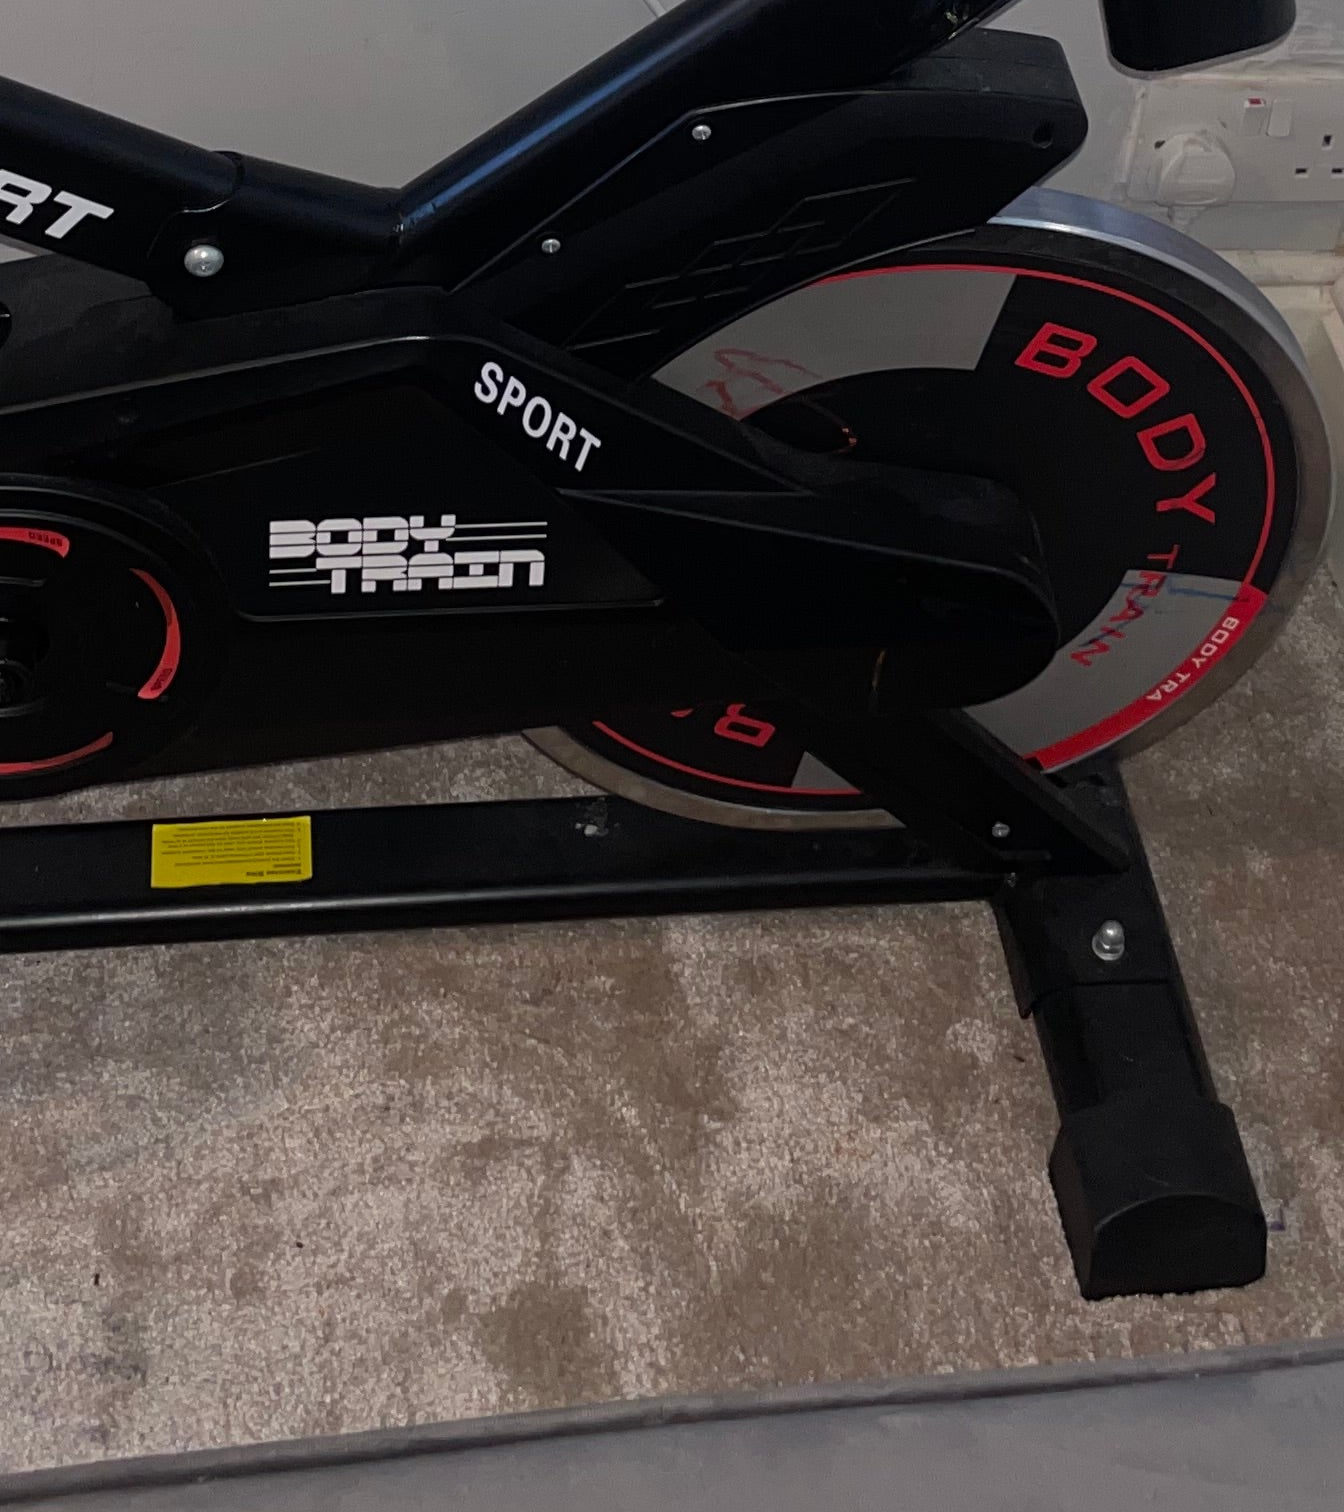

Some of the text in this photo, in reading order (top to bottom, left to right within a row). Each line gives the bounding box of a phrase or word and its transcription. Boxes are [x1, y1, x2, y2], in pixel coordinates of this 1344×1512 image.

[474, 361, 602, 472] SPORT
[1014, 321, 1217, 525] BODY
[269, 514, 456, 559] BODY
[1146, 616, 1240, 701] BODY TRA
